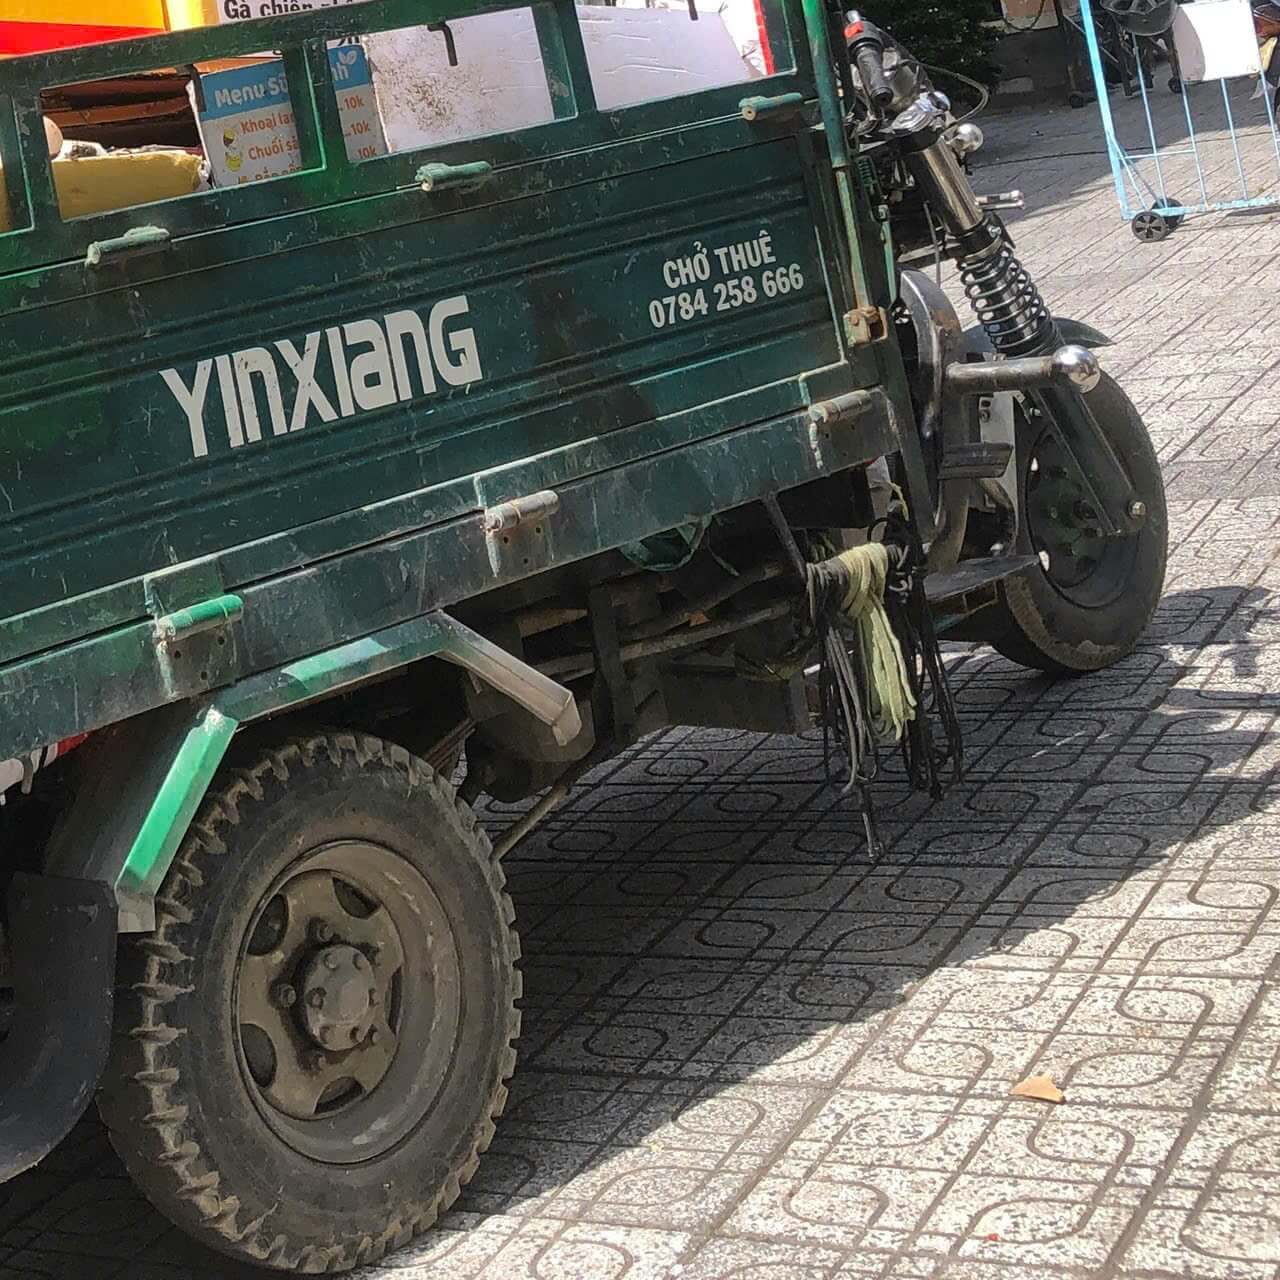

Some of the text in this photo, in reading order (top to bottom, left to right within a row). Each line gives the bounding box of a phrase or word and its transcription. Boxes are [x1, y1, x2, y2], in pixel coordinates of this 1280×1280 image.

[215, 83, 266, 108] Menu
[344, 96, 365, 110] 10k
[240, 113, 277, 134] Khoai
[351, 120, 370, 135] 10k
[248, 136, 284, 160] Chuối
[663, 230, 776, 289] CHỞ THUÊ
[649, 263, 804, 328] 0784 258 666
